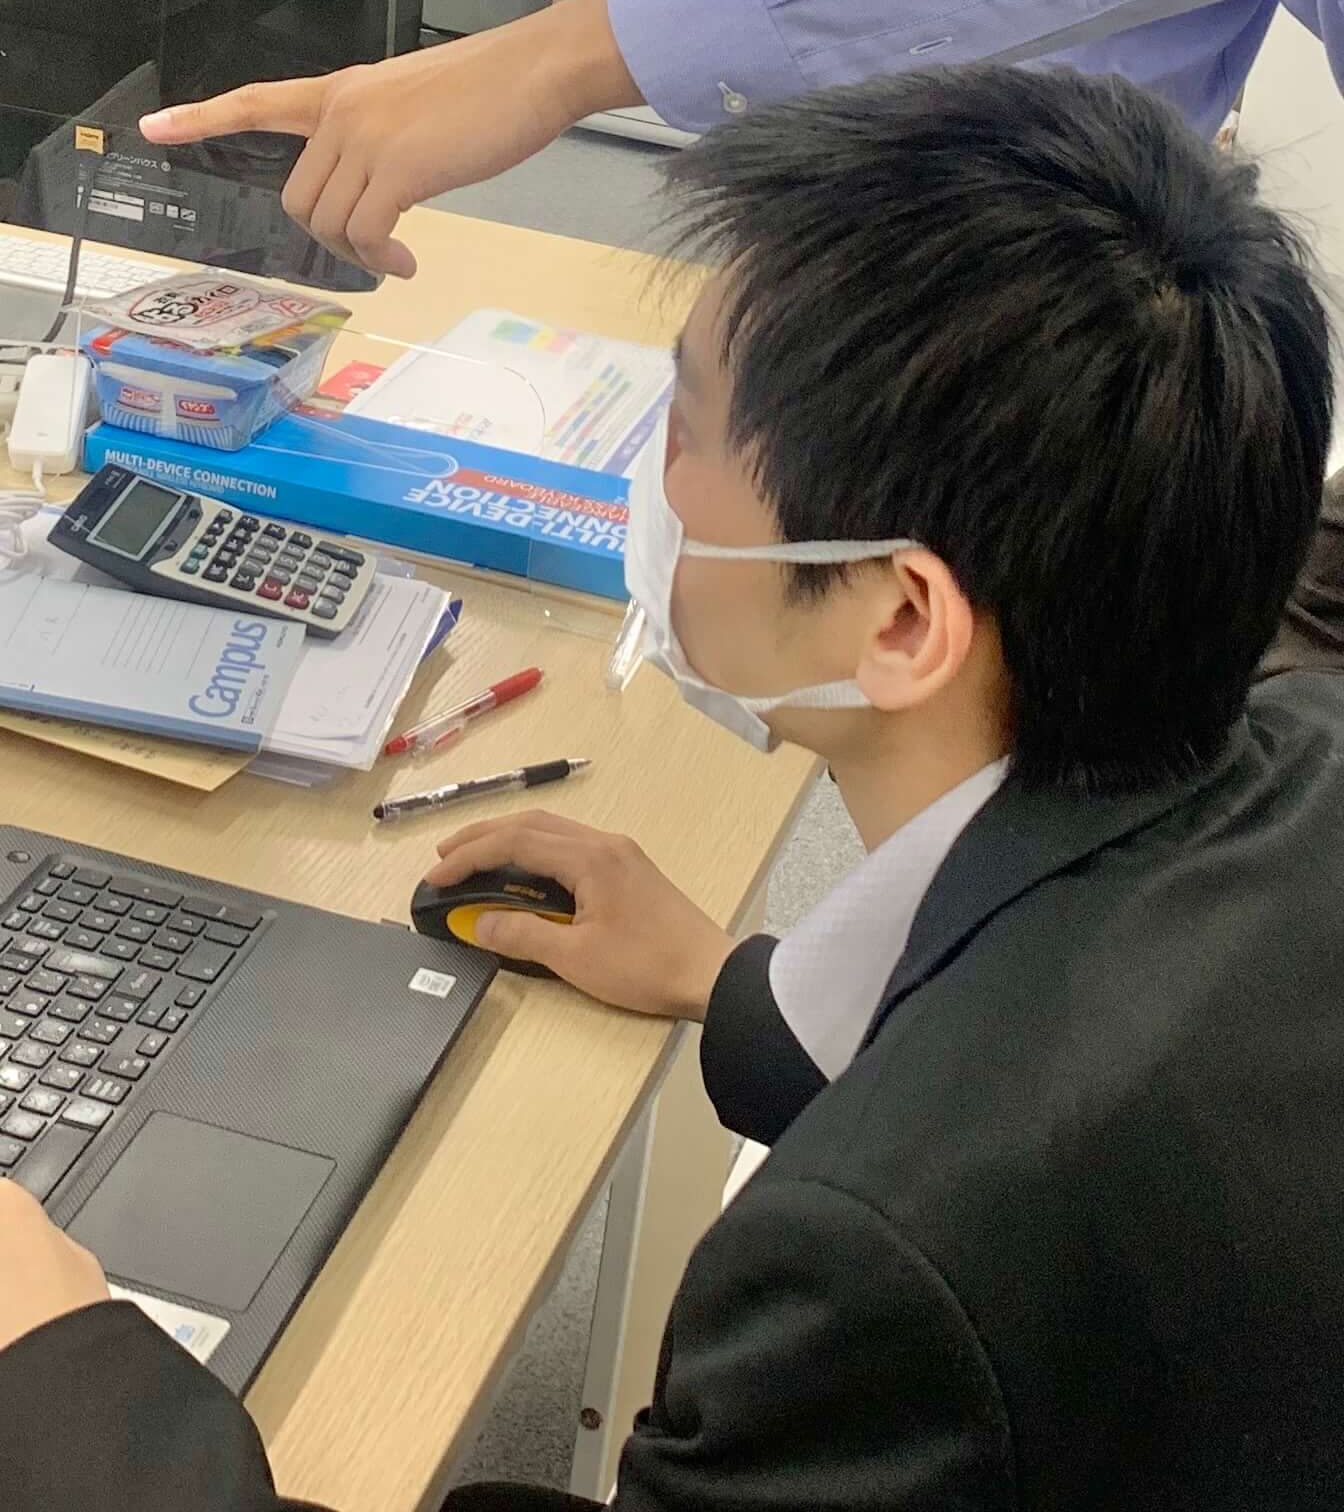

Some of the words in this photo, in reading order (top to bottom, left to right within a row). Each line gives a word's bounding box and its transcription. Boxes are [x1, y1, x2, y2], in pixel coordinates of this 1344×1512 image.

[105, 448, 192, 479] MULTI-DEVICE
[194, 468, 277, 499] CONNECTION
[402, 487, 626, 553] ULTI-DEVICE
[425, 479, 629, 538] ONNECTION
[188, 619, 268, 718] Campus
